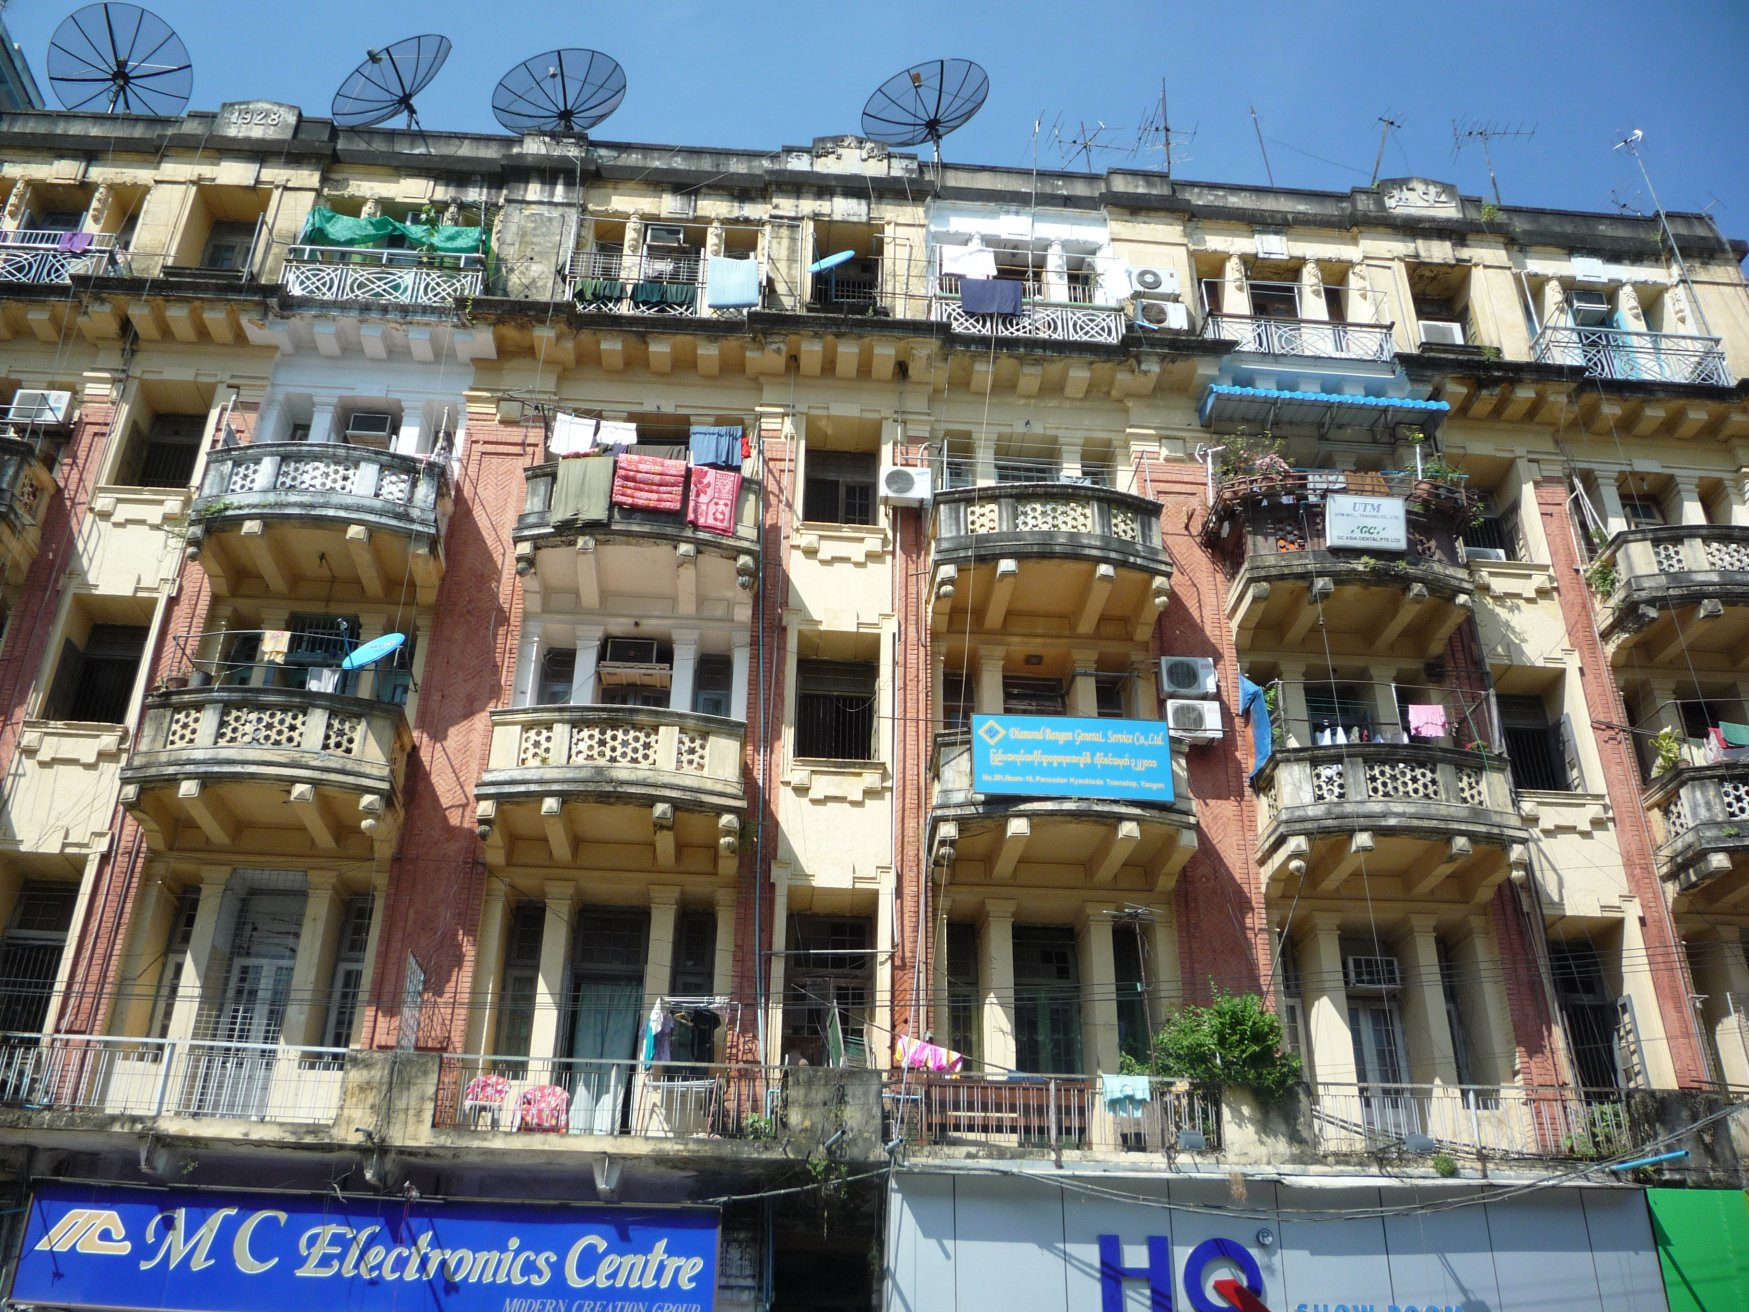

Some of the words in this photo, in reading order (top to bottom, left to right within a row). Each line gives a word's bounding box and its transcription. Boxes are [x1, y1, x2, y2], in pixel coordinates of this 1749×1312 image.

[230, 109, 281, 126] 1928
[1352, 502, 1382, 513] UTM
[1008, 727, 1045, 740] Diamond
[1107, 730, 1133, 744] Service
[1140, 781, 1165, 790] Yangon
[294, 1223, 559, 1288] Electronics
[564, 1233, 704, 1291] Centre
[1098, 1234, 1272, 1312] HQ
[502, 1297, 568, 1312] MODERN
